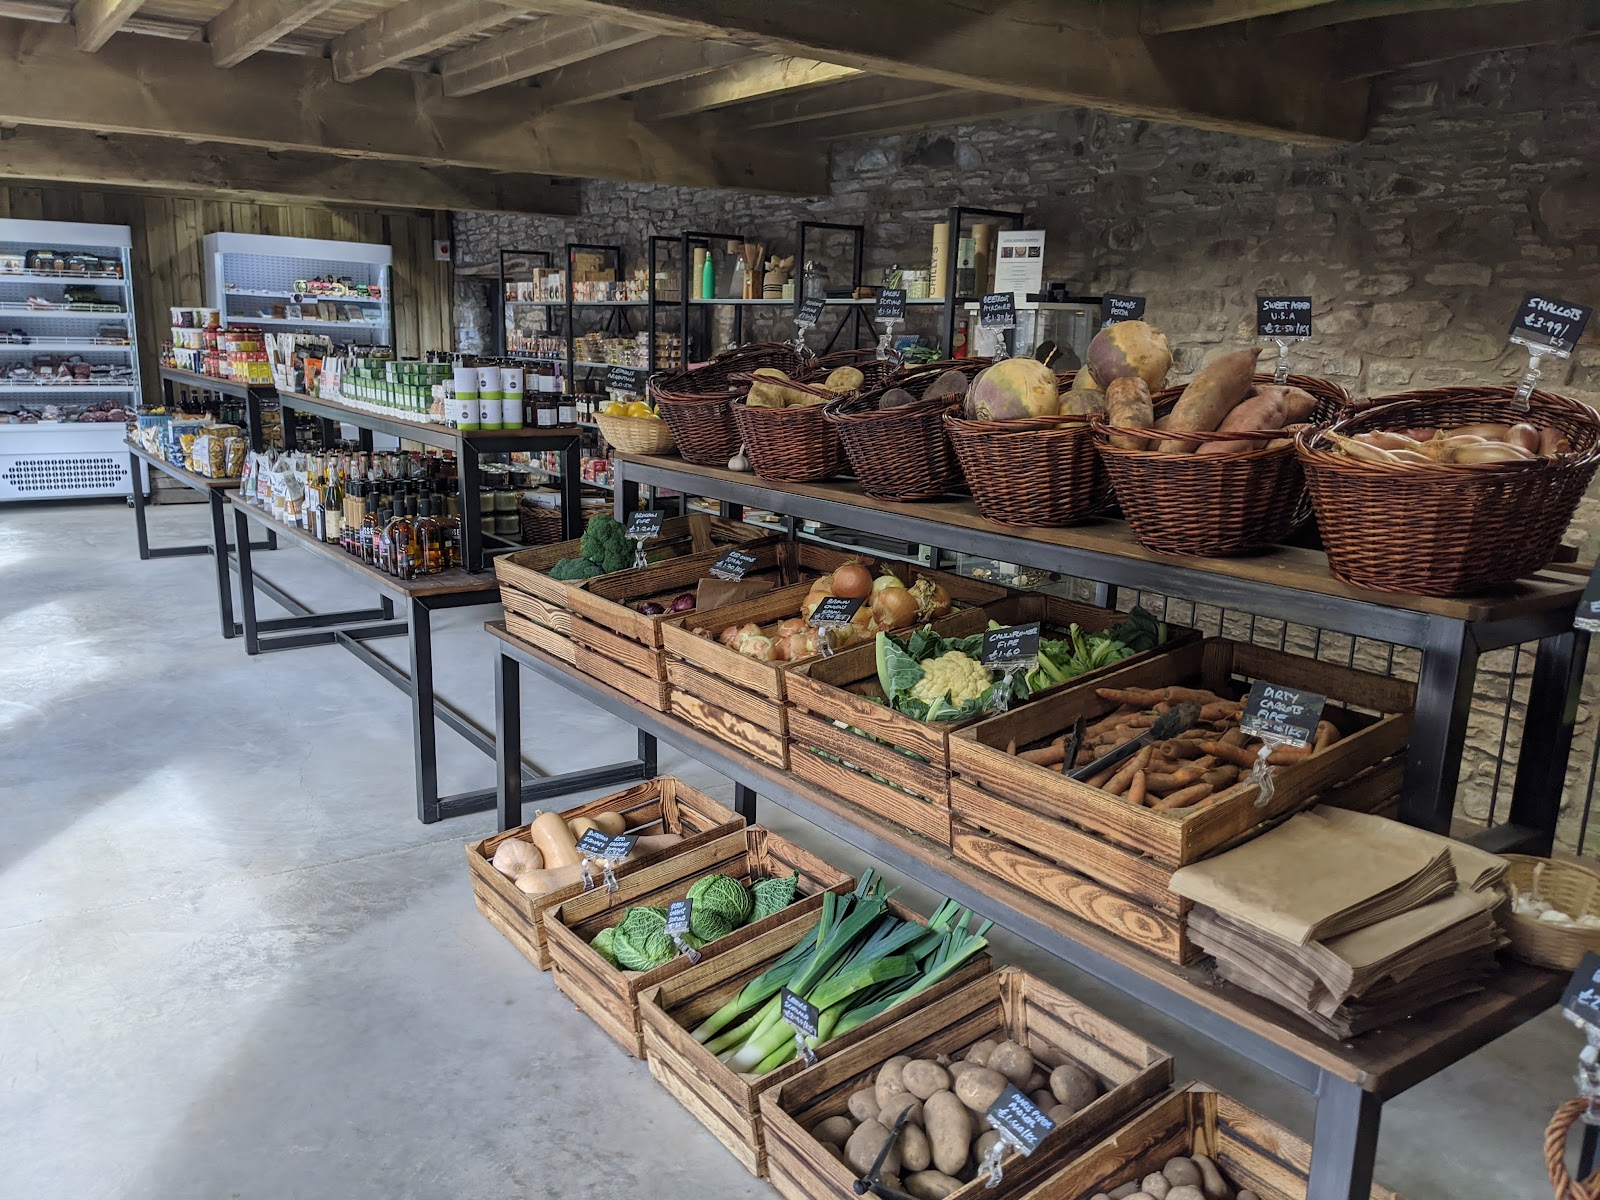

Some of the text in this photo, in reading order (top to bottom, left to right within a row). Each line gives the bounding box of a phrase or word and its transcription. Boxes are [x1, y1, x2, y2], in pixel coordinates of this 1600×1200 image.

[1109, 298, 1136, 310] TURNIPS
[1263, 300, 1289, 311] SWEET
[1527, 297, 1583, 321] SHALLOTS
[1271, 311, 1296, 320] U.S.A
[611, 367, 635, 376] LEMONS
[988, 627, 1038, 642] CAULIFLOWER
[996, 638, 1020, 649] FIFE
[988, 648, 1021, 661] £1.60
[1263, 686, 1299, 704] DIRTY
[1259, 698, 1305, 715] CARROTS
[1256, 709, 1289, 724] FIFE
[1011, 1093, 1053, 1130] MARIS PIPER
